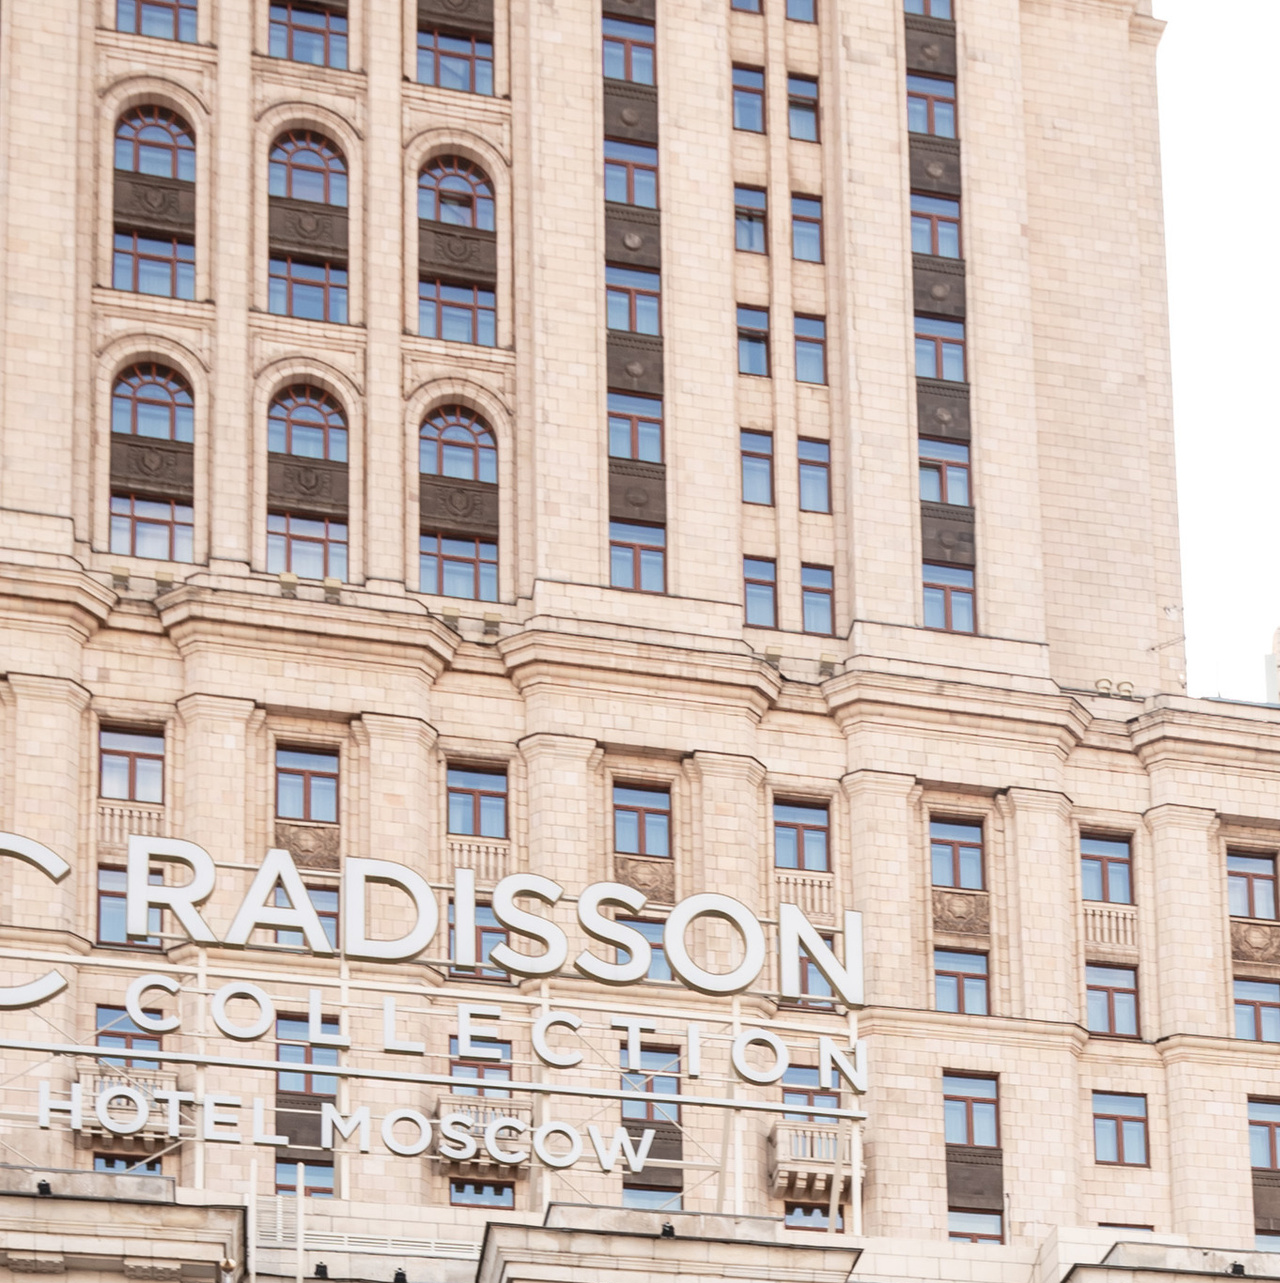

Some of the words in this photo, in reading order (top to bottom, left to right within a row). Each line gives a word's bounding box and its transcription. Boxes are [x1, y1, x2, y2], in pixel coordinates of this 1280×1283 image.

[126, 834, 865, 1006] RADISSON
[125, 974, 868, 1094] COLLECTION
[38, 1081, 290, 1146] HOTEL
[321, 1102, 656, 1173] MOSCOW
